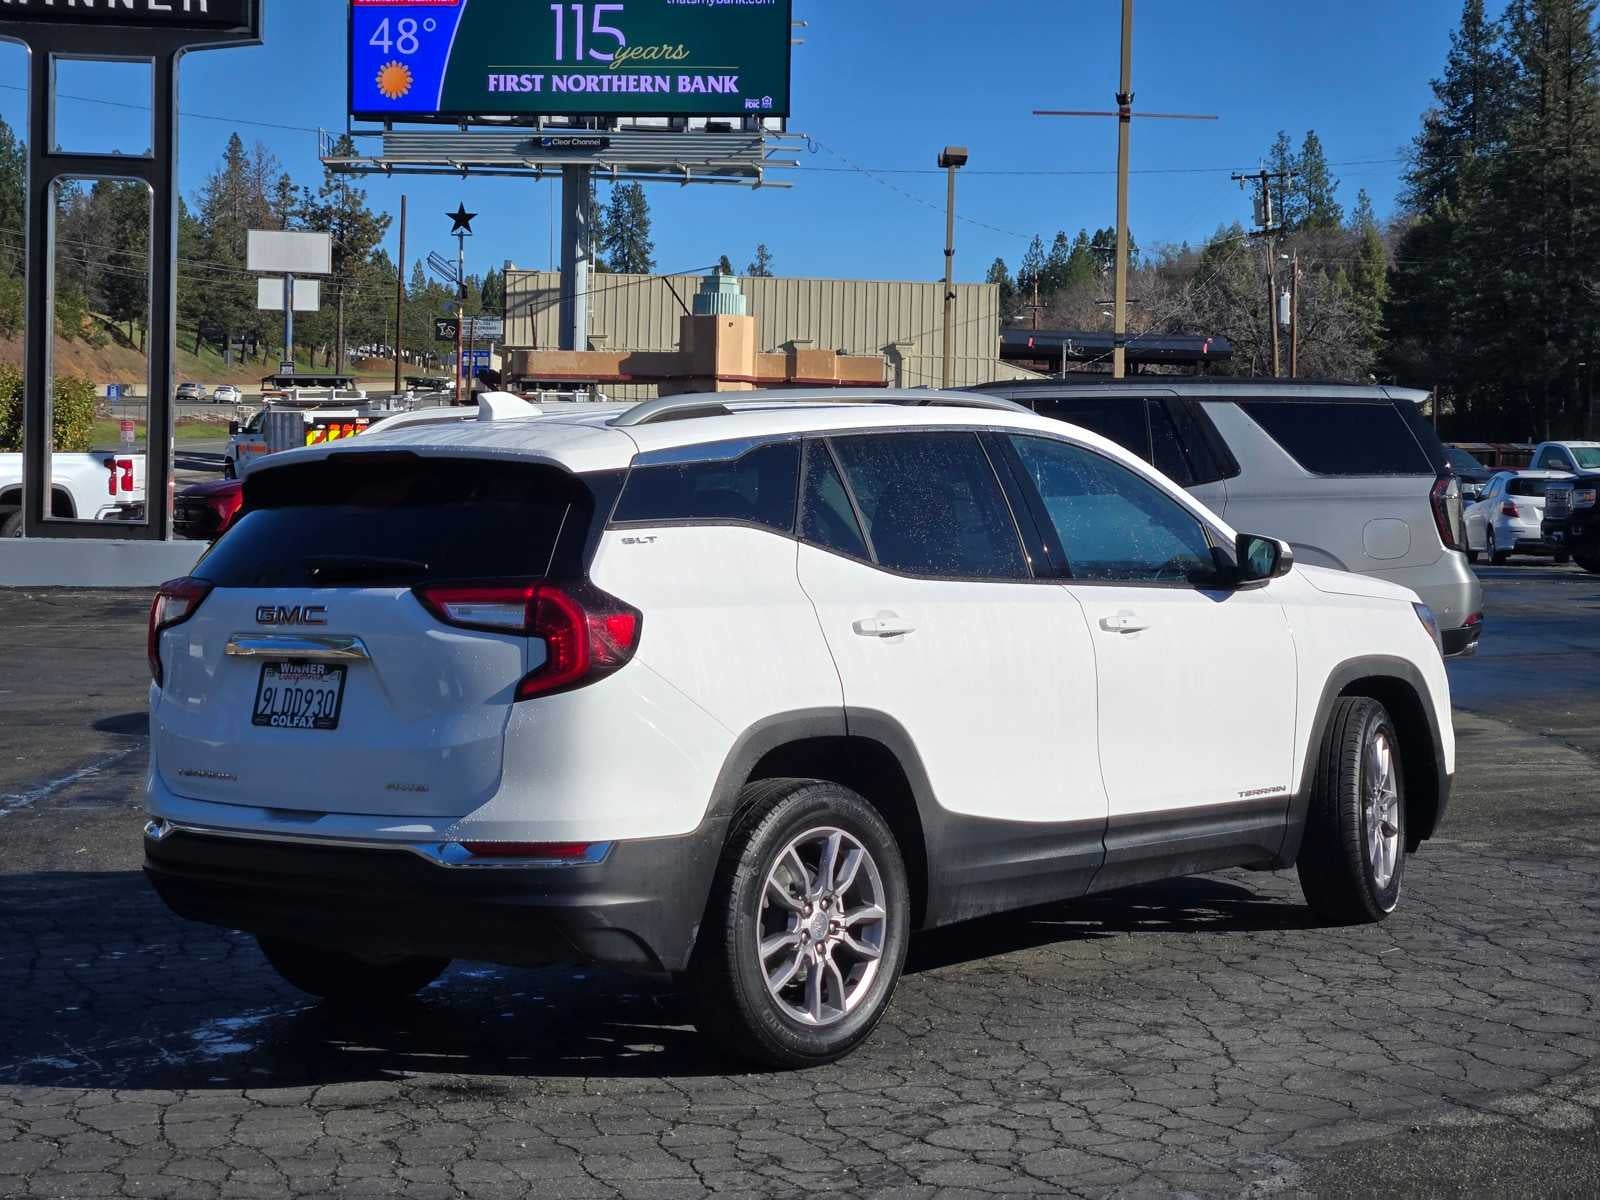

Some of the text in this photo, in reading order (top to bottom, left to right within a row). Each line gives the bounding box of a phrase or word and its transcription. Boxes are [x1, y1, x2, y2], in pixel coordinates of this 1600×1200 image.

[550, 3, 626, 61] 115
[609, 43, 690, 69] years
[488, 75, 739, 93] FIRST NORTHERN BANK
[552, 138, 601, 146] Clear Channel
[256, 605, 328, 626] GMC
[280, 663, 325, 674] WINNER
[270, 715, 316, 729] COLFAX
[1238, 785, 1287, 798] TERRAIN
